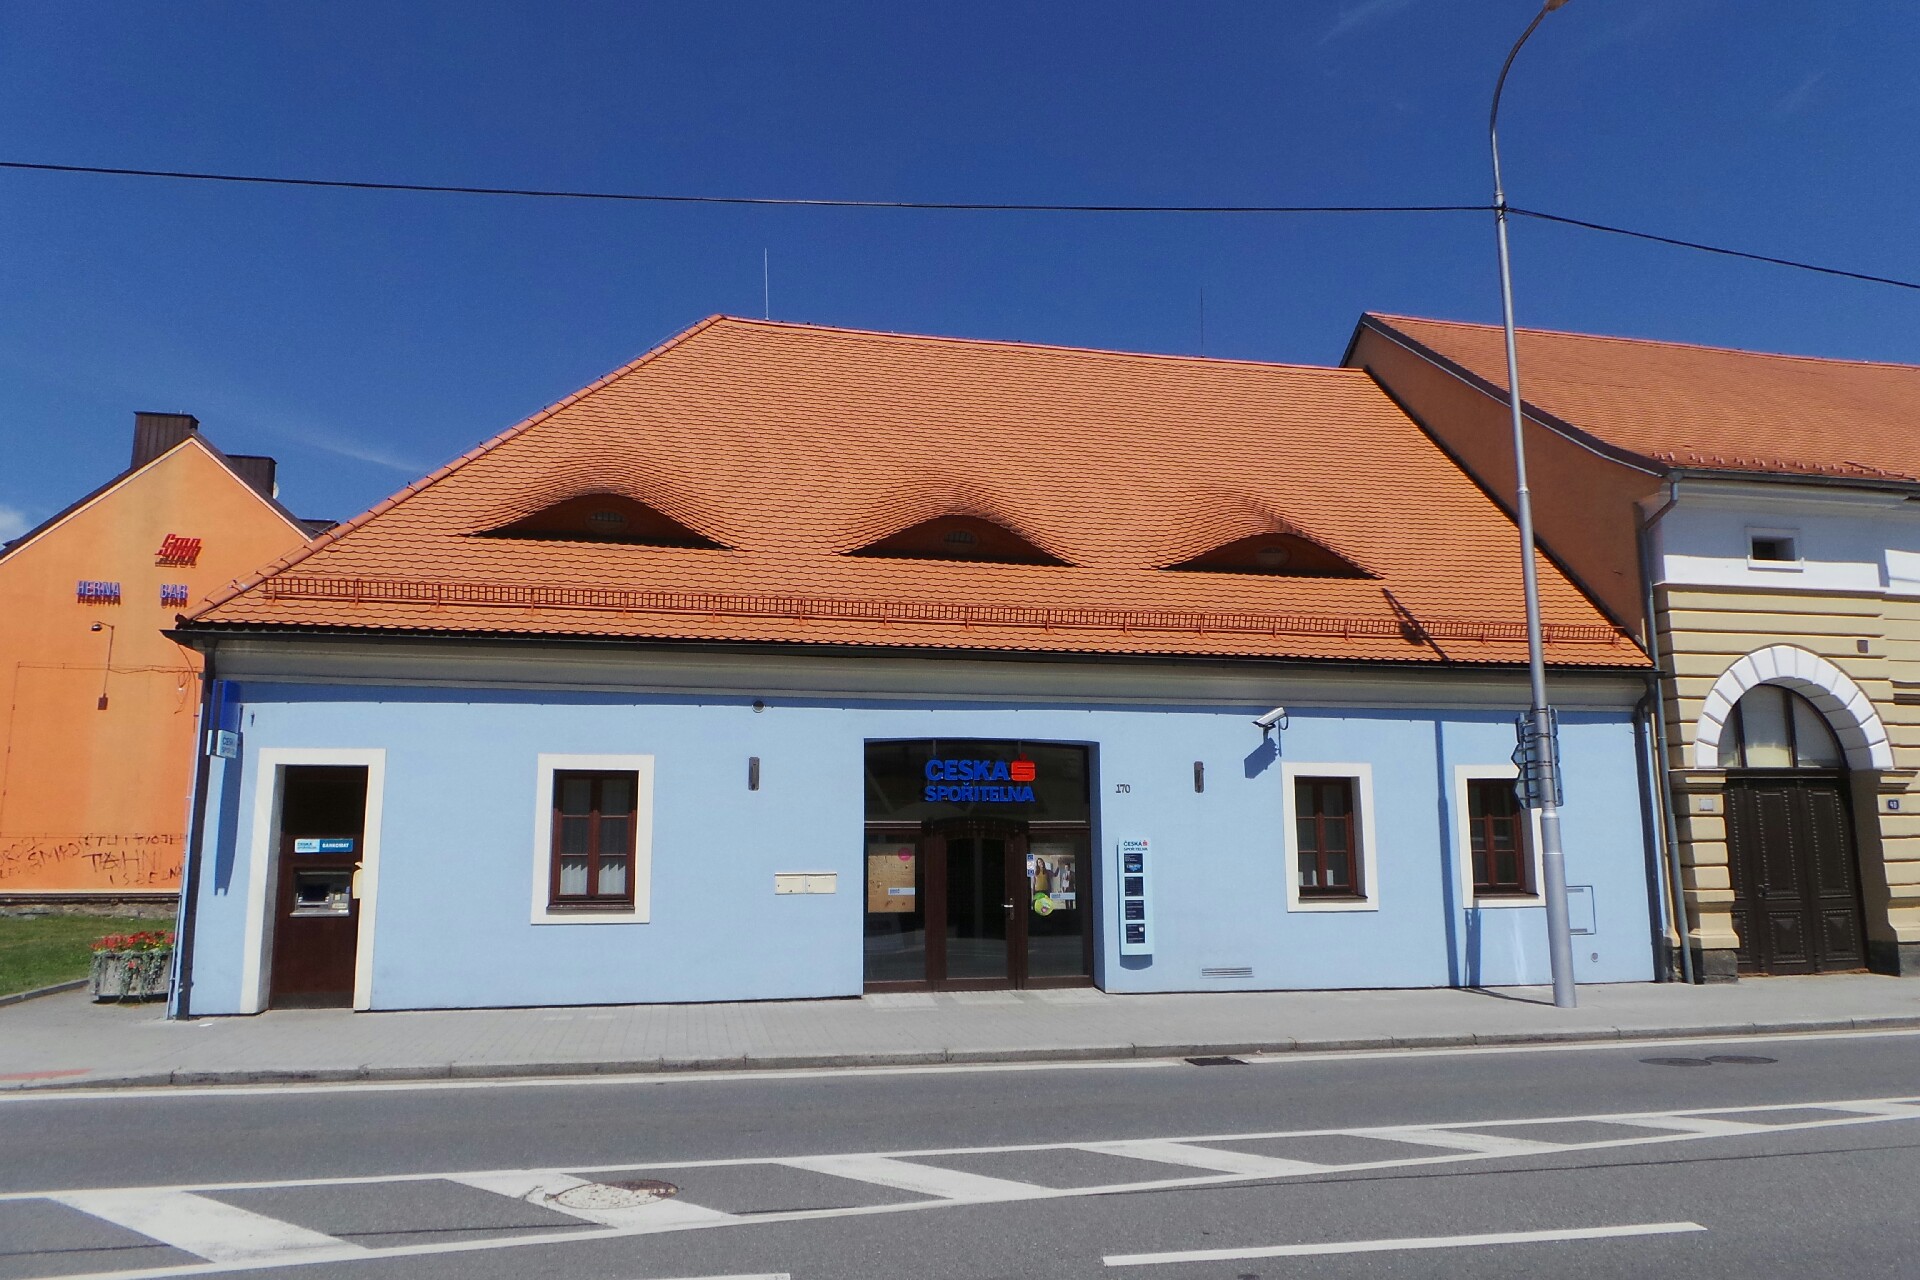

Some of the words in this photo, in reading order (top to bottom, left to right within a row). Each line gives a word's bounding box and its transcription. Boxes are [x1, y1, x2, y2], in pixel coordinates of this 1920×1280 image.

[77, 580, 121, 597] HERNA
[160, 583, 188, 599] BAR
[924, 781, 1036, 802] SPOŘITELNA
[1115, 783, 1131, 794] 170
